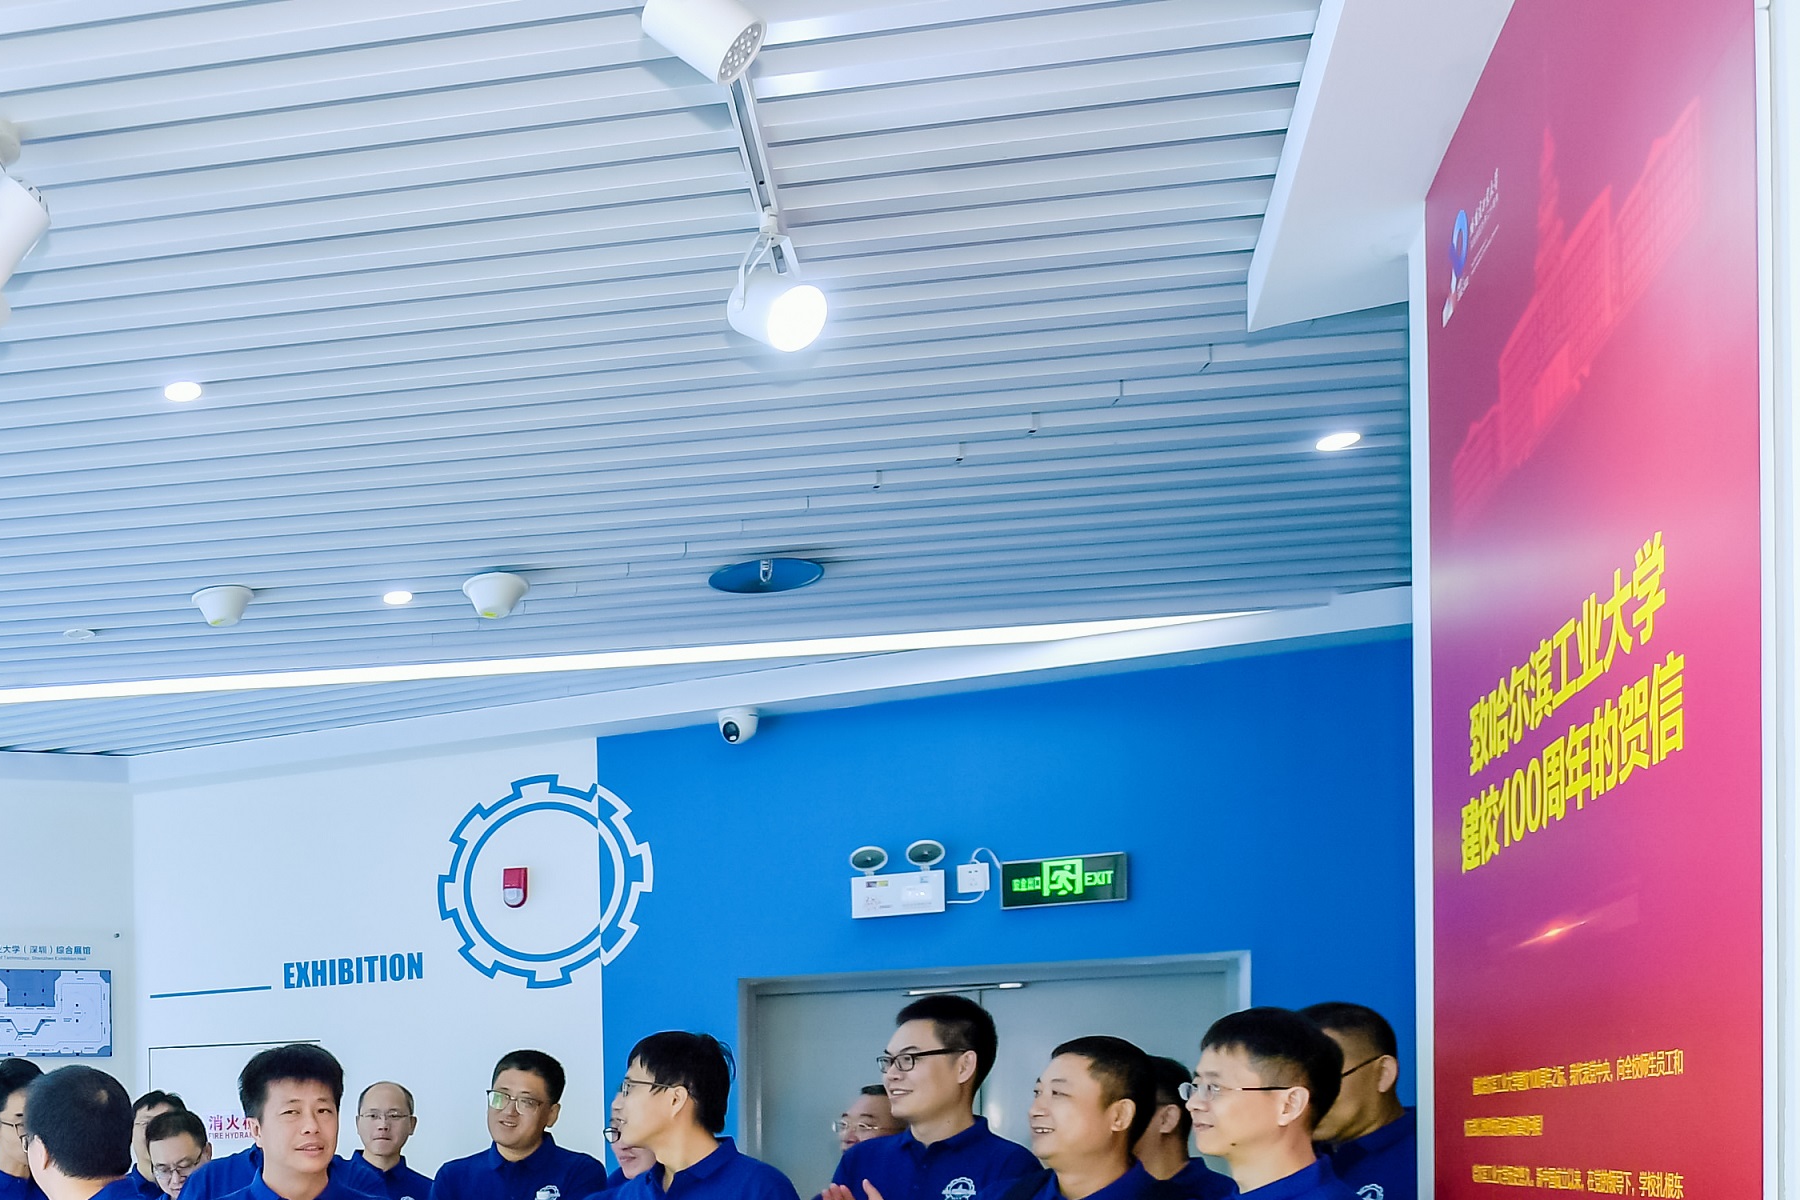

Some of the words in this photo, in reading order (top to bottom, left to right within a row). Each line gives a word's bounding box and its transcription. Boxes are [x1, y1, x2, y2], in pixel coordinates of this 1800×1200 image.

[1469, 531, 1666, 776] 致哈尔滨工业大学
[1461, 650, 1684, 874] 建校100周年的贺信
[1084, 870, 1114, 886] EXIT
[283, 952, 423, 989] EXHIBITION
